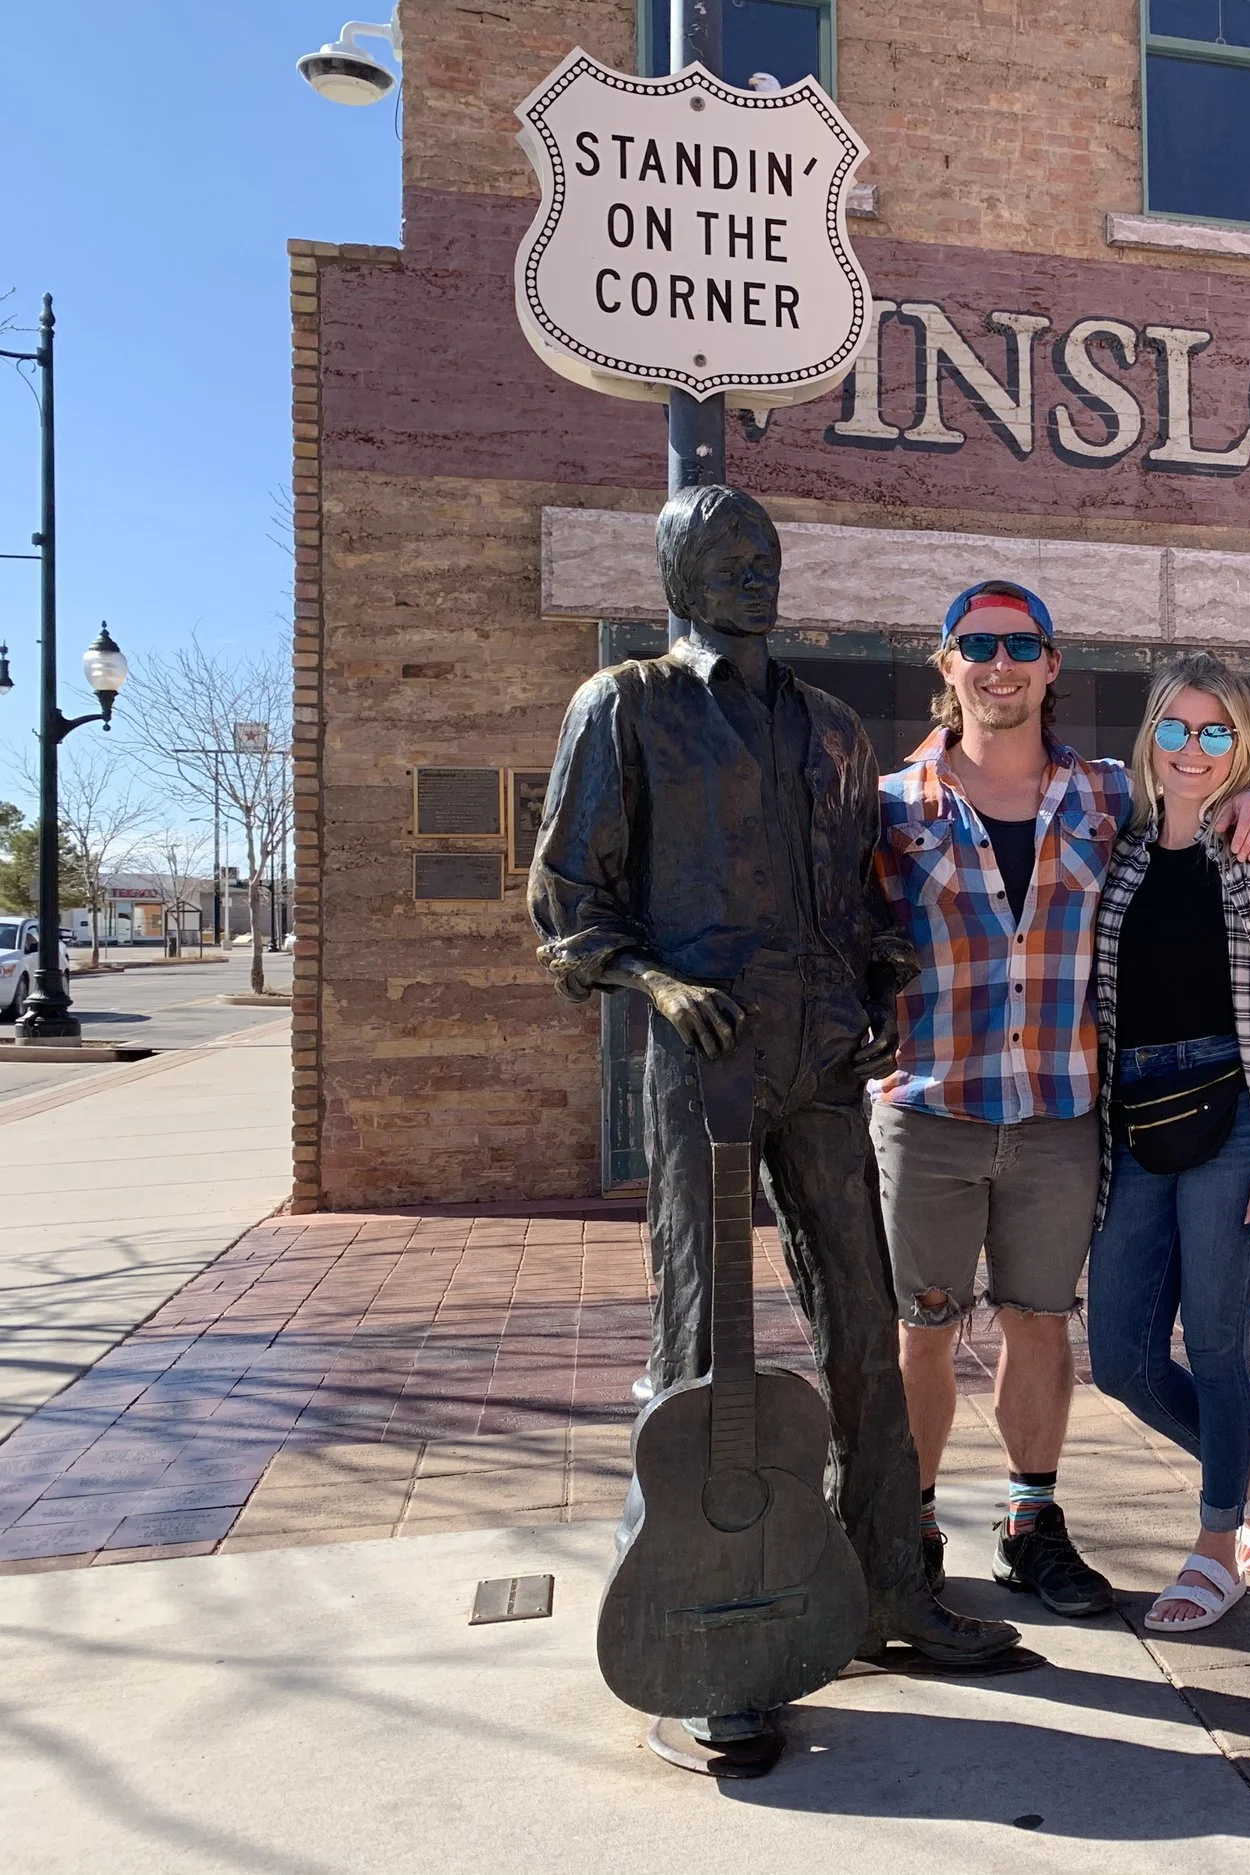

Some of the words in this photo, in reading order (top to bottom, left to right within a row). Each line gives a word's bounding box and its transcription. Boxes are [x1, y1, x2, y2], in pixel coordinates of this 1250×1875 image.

[575, 131, 818, 197] STANDIN'
[606, 202, 673, 252] ON
[697, 210, 788, 263] THE
[595, 268, 801, 330] CORNER
